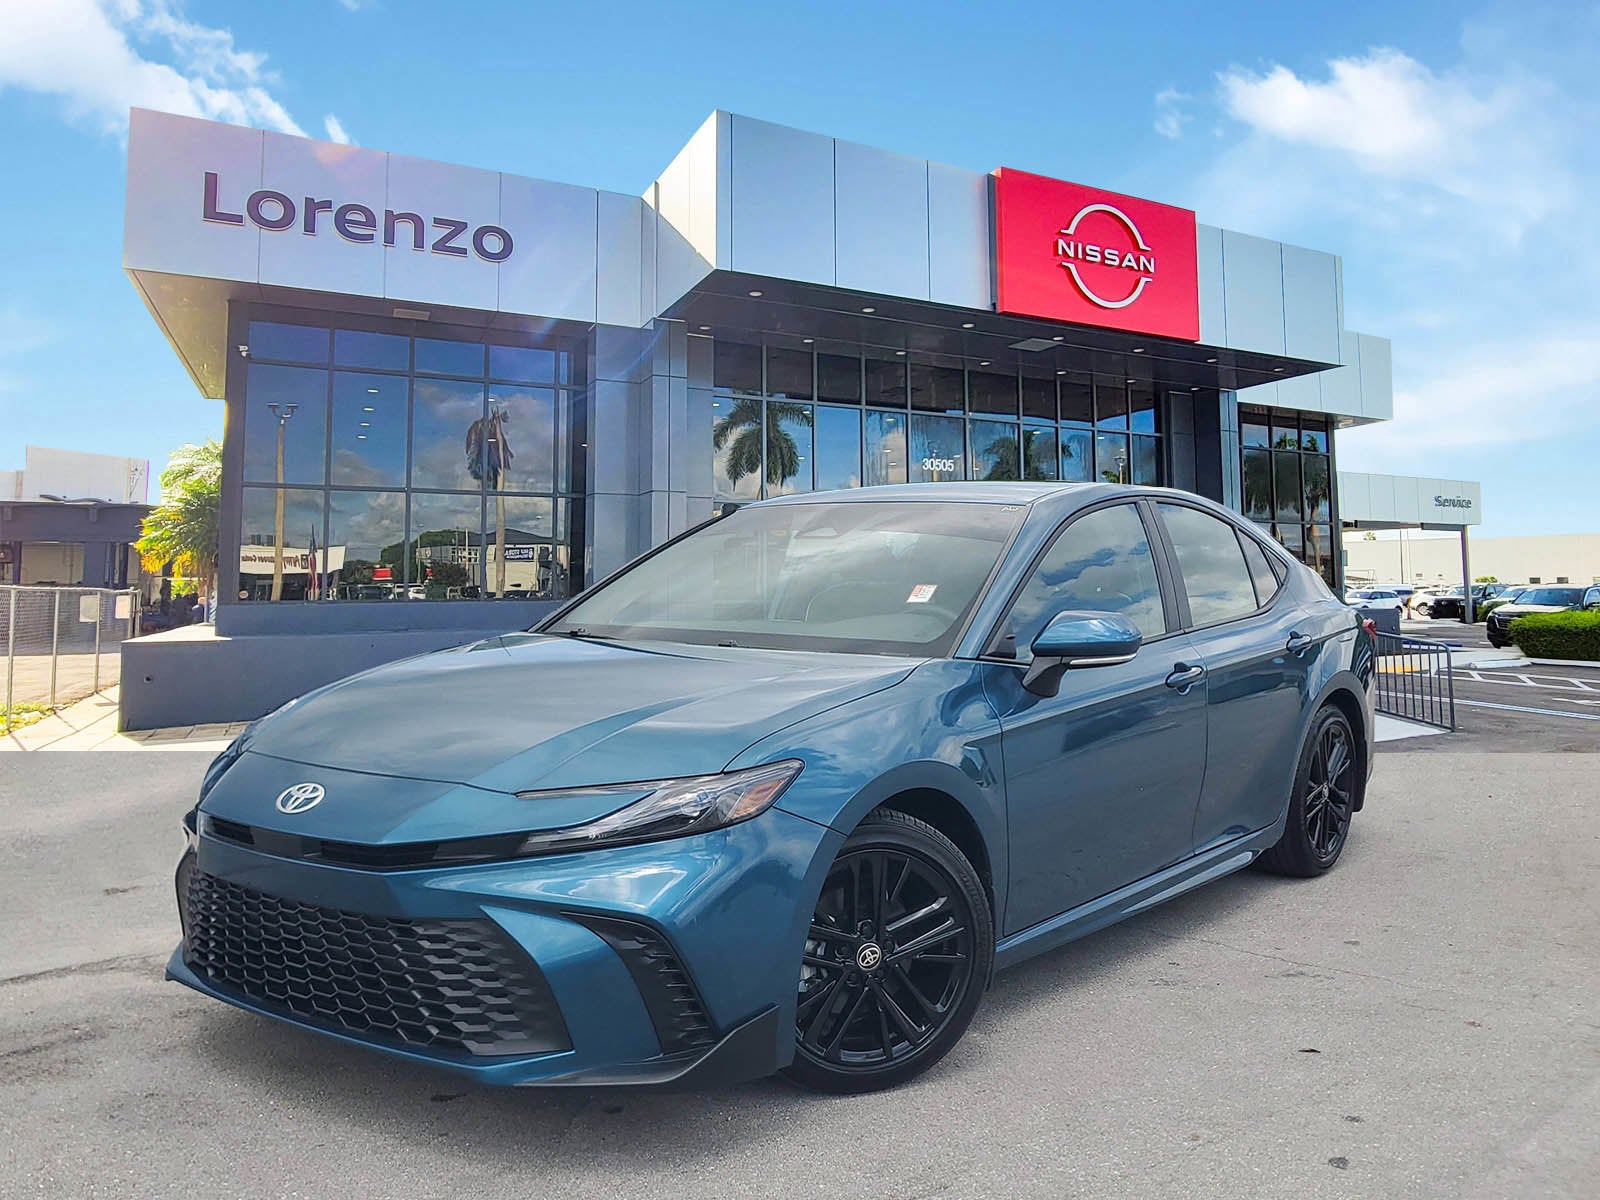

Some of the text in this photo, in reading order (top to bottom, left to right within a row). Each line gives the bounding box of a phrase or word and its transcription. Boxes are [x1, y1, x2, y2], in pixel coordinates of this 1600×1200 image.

[202, 171, 514, 262] Lorenzo
[1057, 238, 1155, 273] NISSAN
[922, 458, 955, 472] 30505
[1433, 495, 1472, 509] Service
